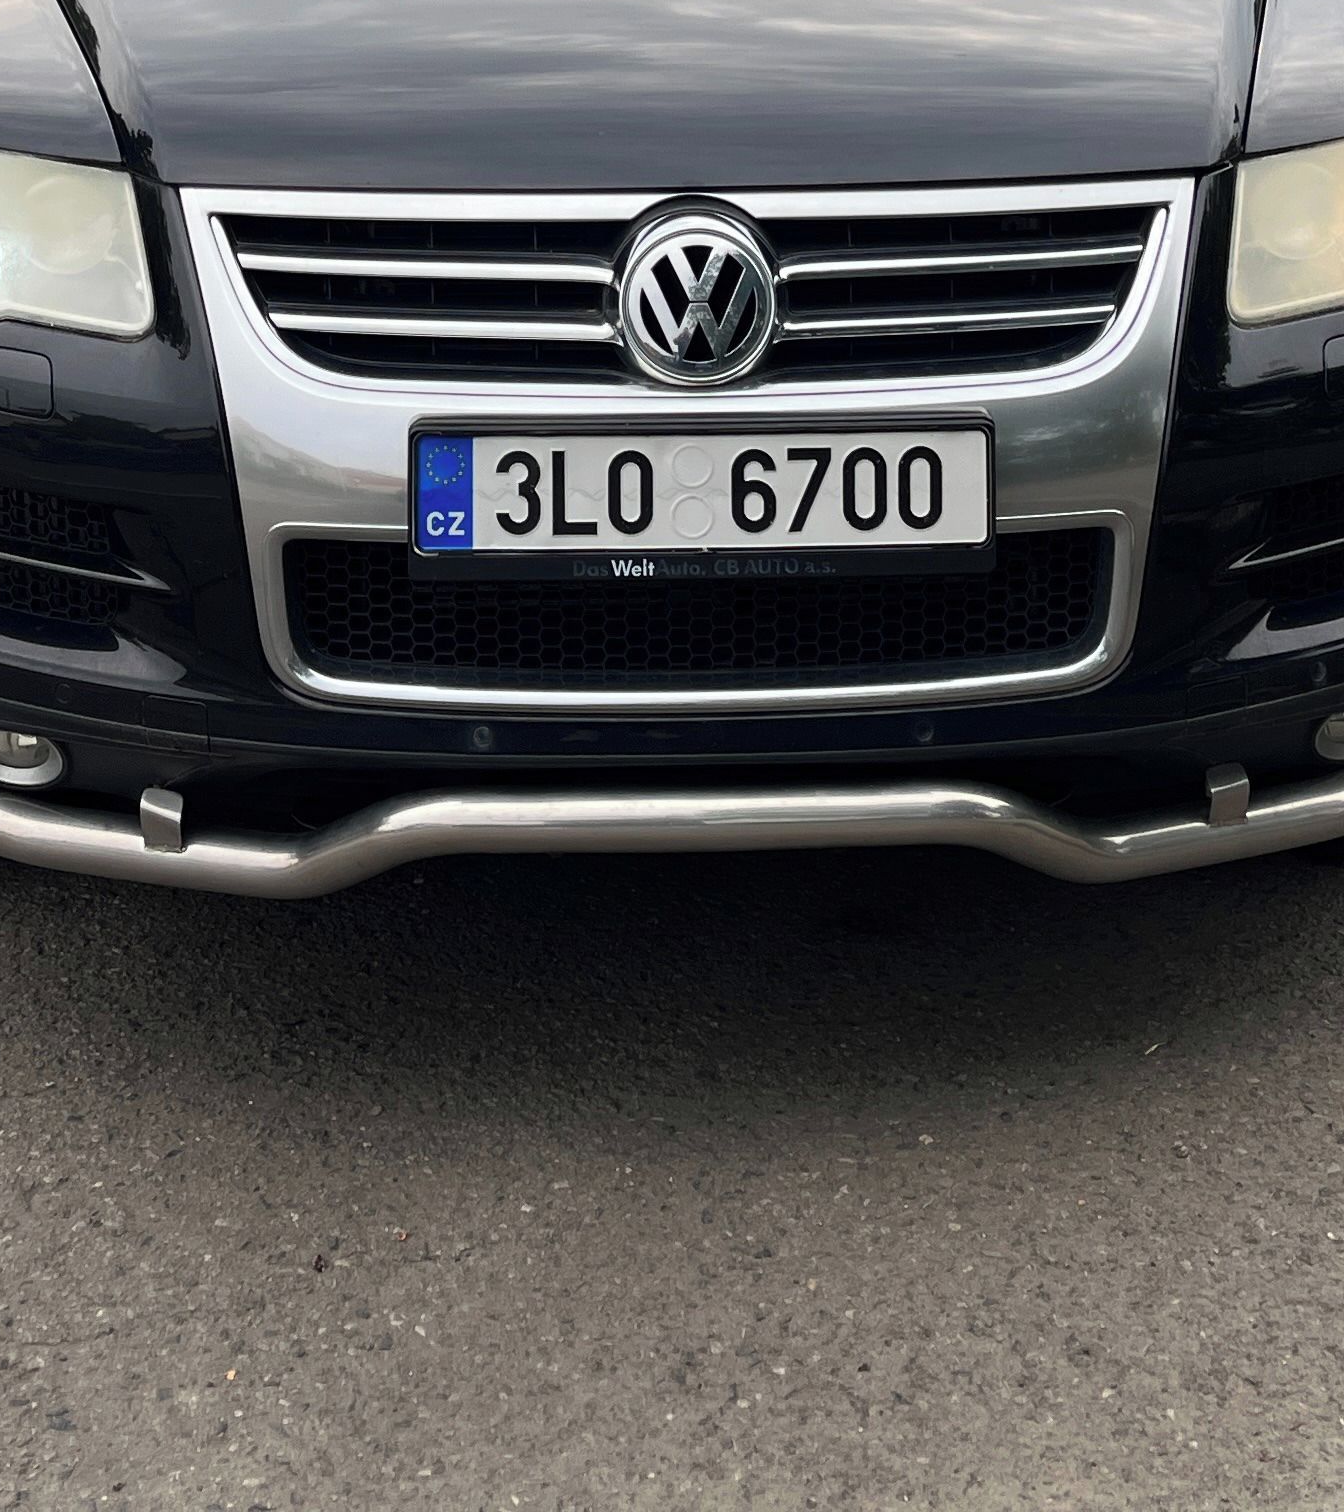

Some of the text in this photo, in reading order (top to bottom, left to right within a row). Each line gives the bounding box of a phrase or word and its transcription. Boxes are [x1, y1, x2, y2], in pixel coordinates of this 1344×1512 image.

[631, 229, 764, 372] VW
[495, 445, 943, 536] 3L0 6700
[426, 511, 465, 536] CZ
[572, 561, 609, 578] Das
[713, 559, 739, 576] CB
[744, 558, 798, 575] AUTO
